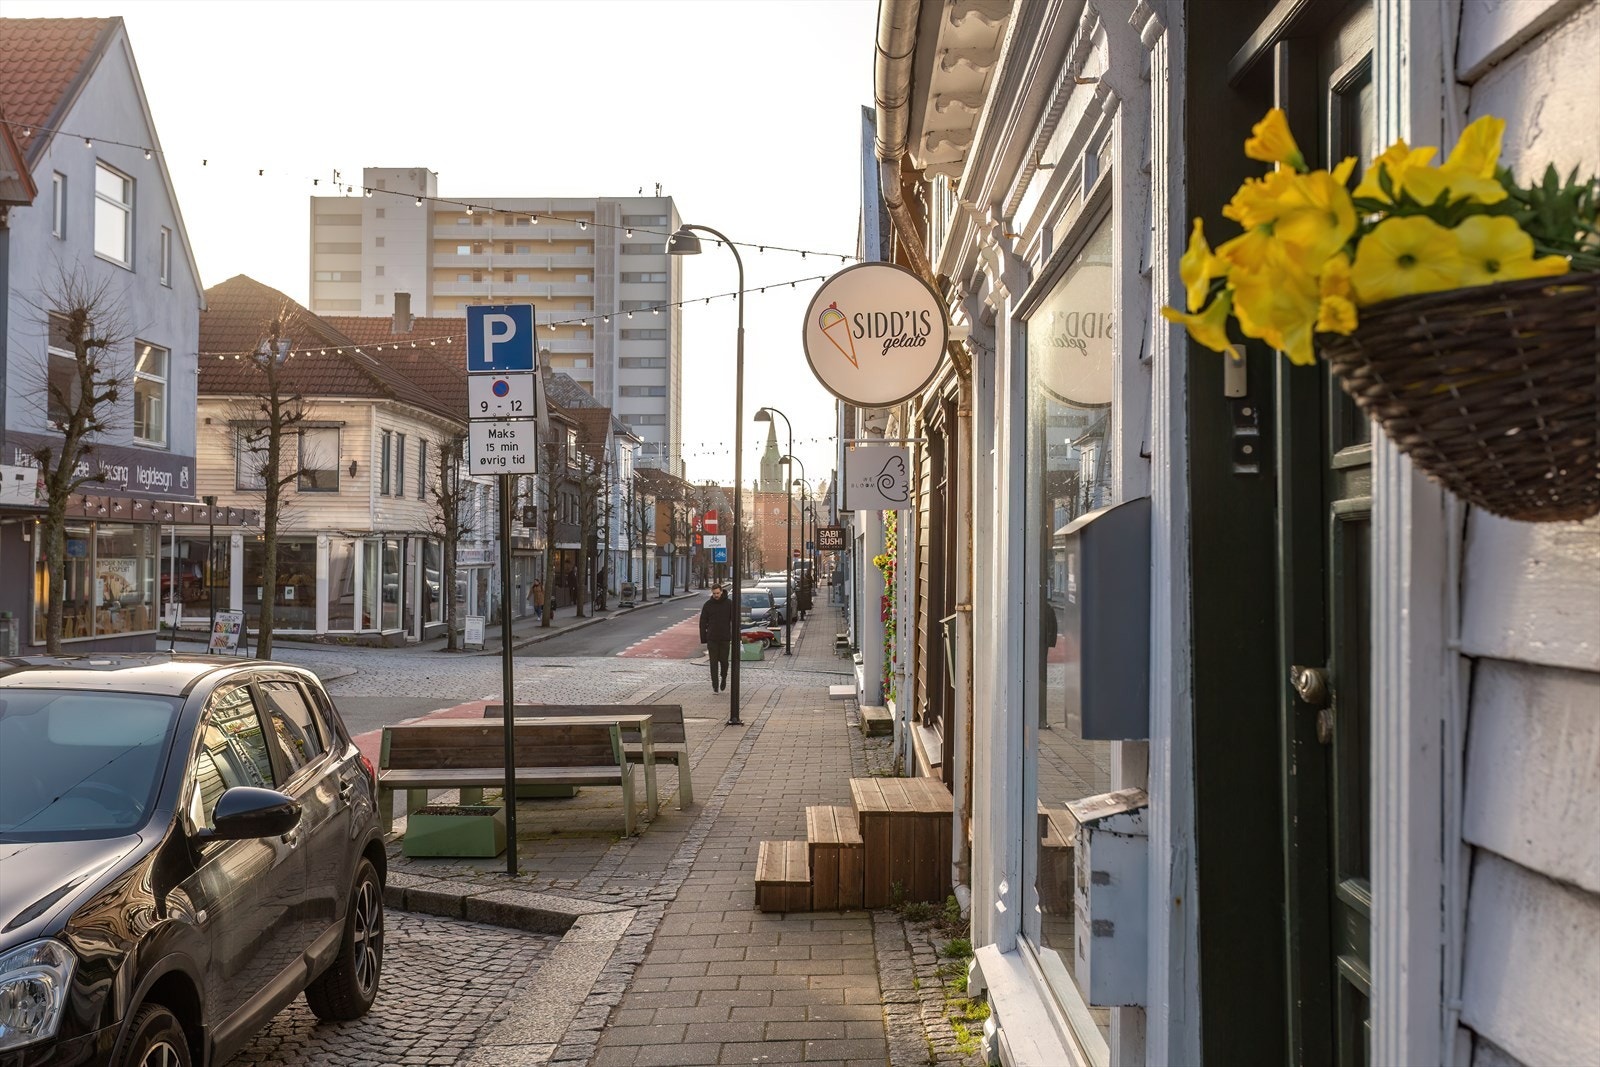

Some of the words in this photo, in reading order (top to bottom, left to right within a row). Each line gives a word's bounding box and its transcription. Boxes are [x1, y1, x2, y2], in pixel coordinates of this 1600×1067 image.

[853, 309, 931, 339] SIDD'IS
[483, 313, 517, 363] P
[881, 333, 927, 356] gelato
[480, 400, 488, 412] 9
[510, 400, 523, 412] 12
[488, 429, 516, 439] Maks
[486, 443, 495, 452] 15
[500, 442, 519, 452] min
[480, 455, 507, 467] øvrig
[512, 454, 526, 465] tid
[820, 530, 839, 538] SABI
